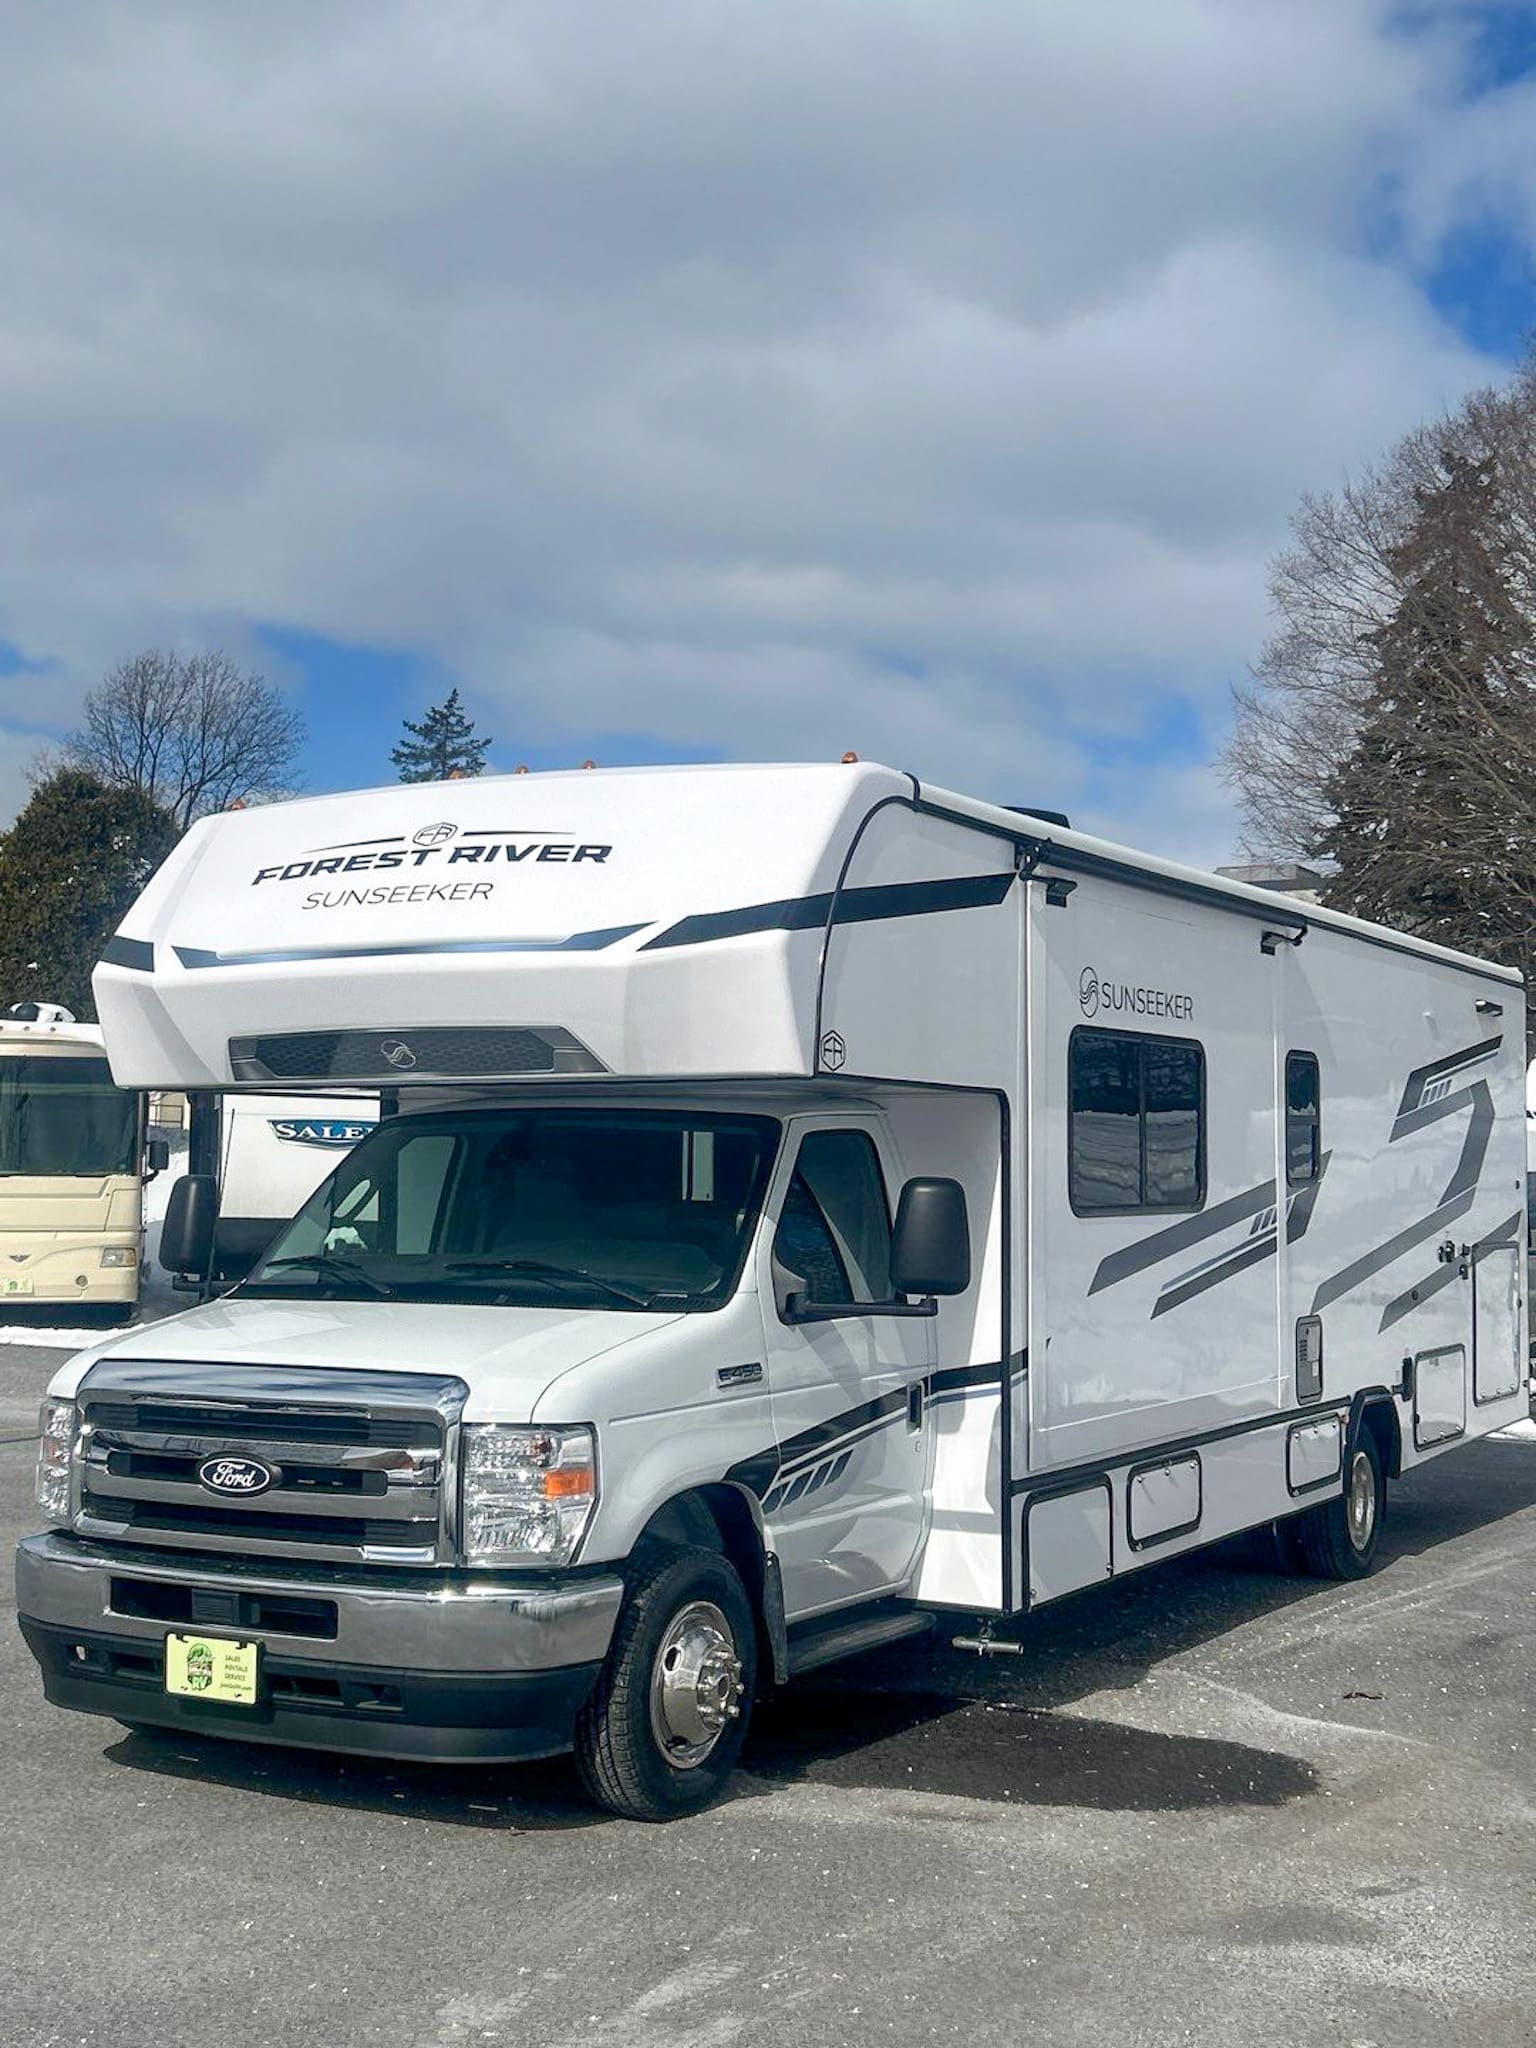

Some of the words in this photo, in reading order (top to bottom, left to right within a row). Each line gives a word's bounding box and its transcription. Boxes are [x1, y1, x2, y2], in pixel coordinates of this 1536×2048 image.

[251, 848, 442, 886] FOREST
[448, 844, 614, 864] RIVER
[301, 882, 494, 910] SUNSEEKER
[1101, 982, 1194, 1021] SUNSEEKER
[276, 1123, 374, 1140] SALE
[213, 1462, 257, 1487] Ford
